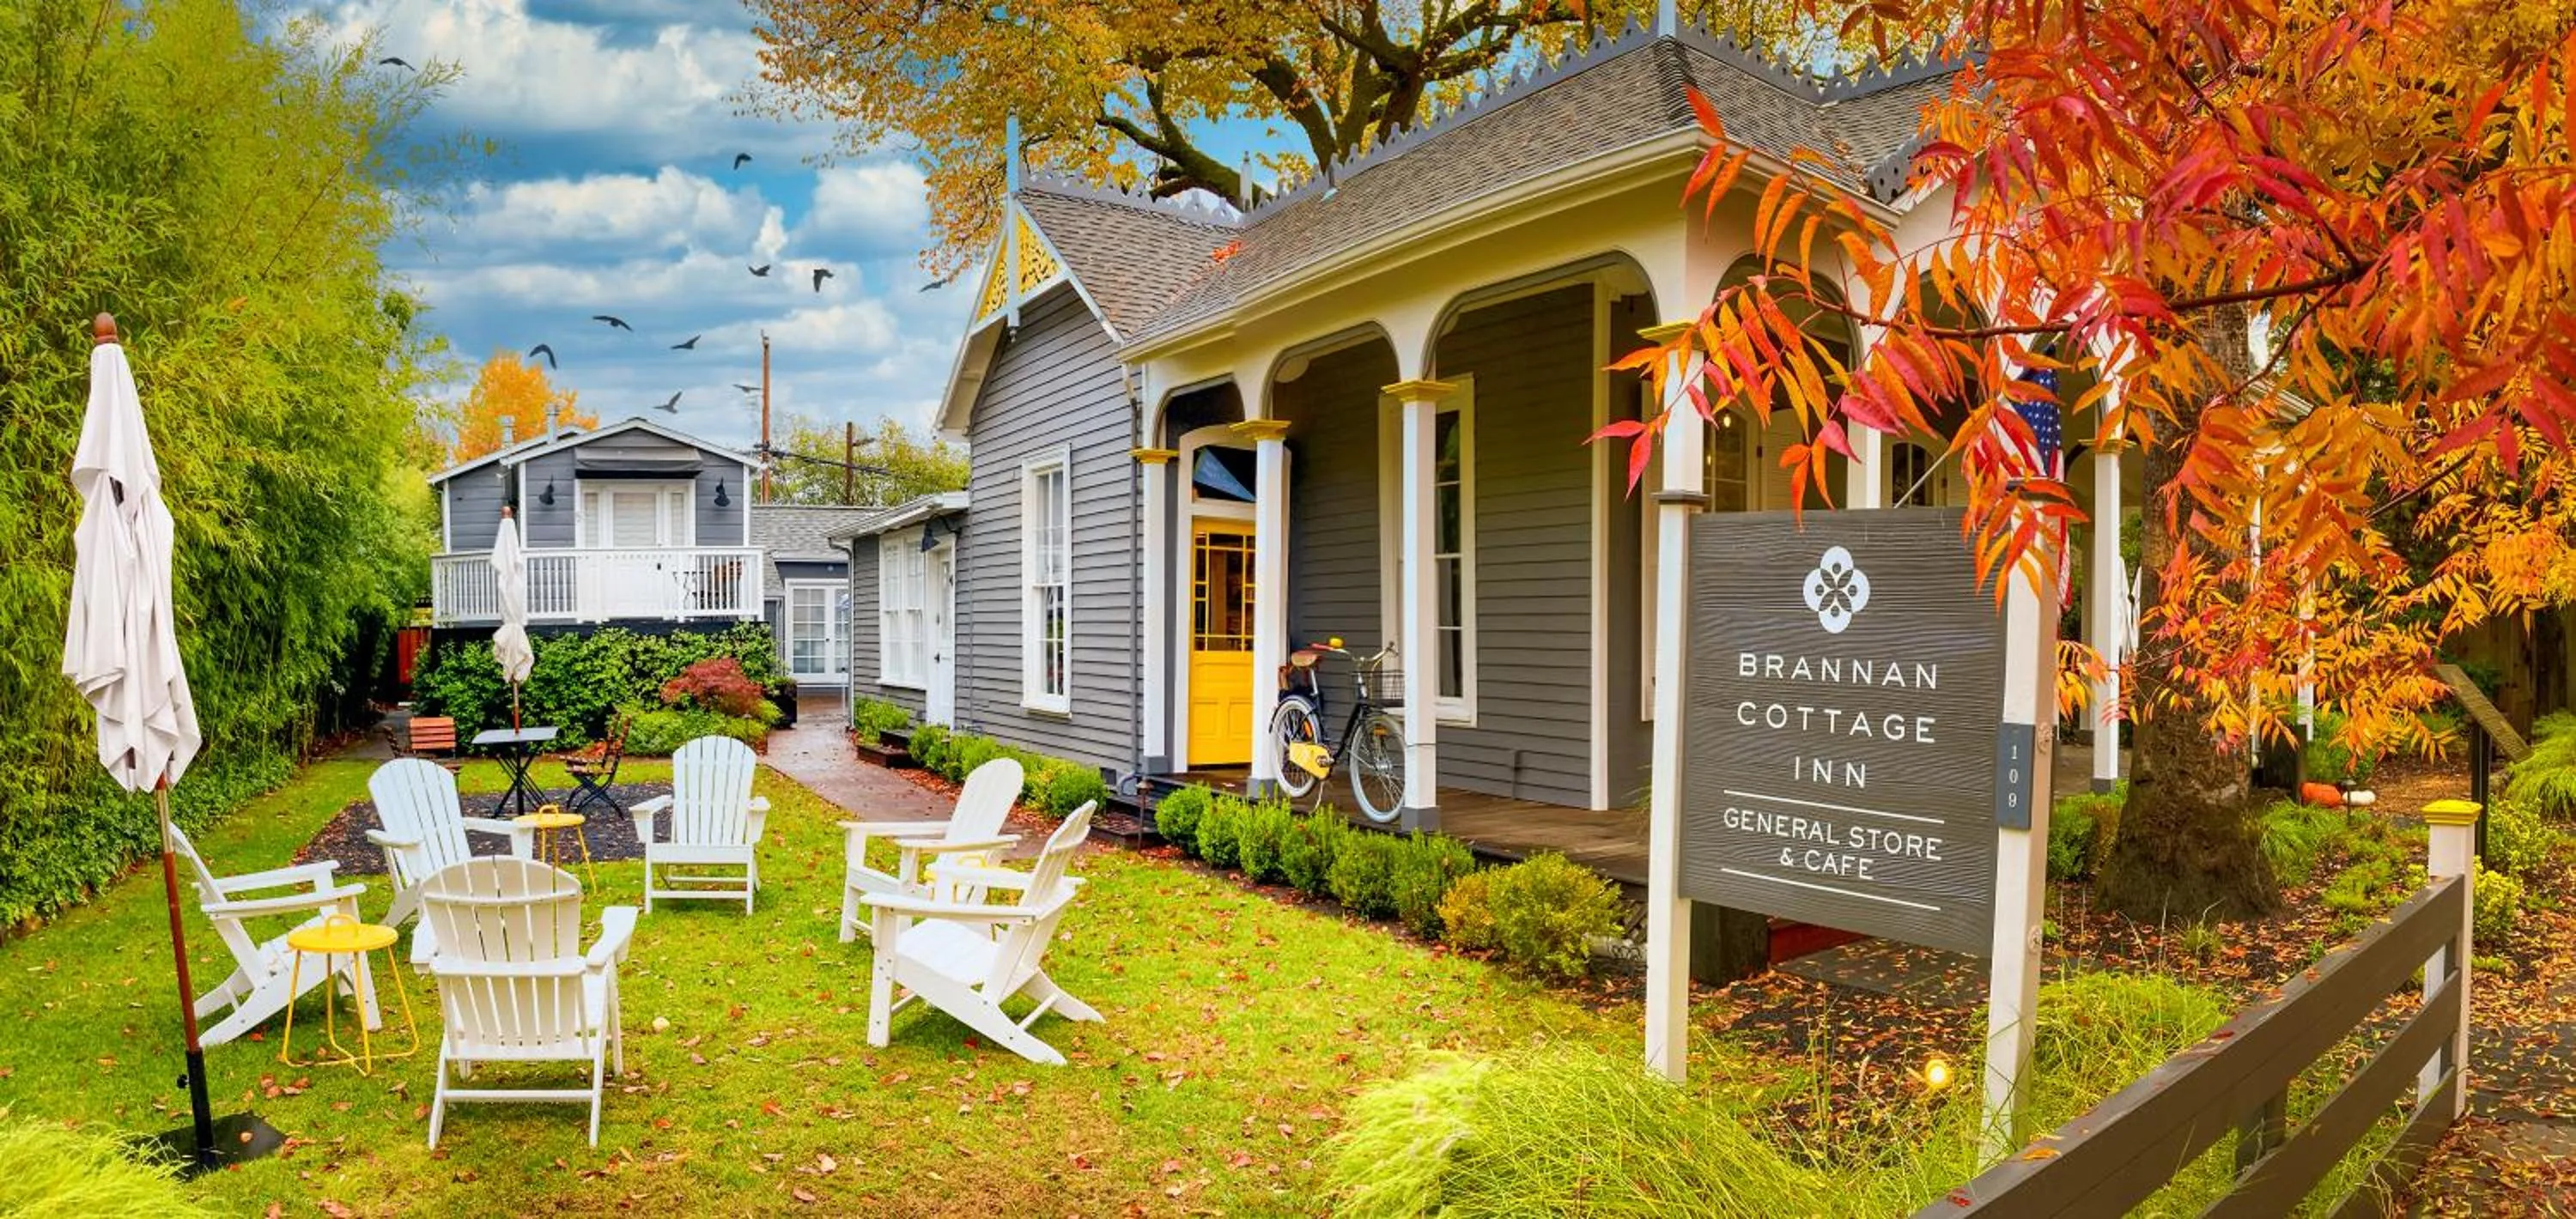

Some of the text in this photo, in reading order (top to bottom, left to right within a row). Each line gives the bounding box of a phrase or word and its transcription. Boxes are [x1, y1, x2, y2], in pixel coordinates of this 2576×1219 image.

[1739, 653, 1938, 689] BRANNAN
[1736, 701, 1936, 744] COTTAGE
[1794, 755, 1868, 789] INN
[2008, 743, 2020, 809] 109
[1723, 807, 1943, 861] GENERAL STORE
[1779, 847, 1874, 881] & CAFE
